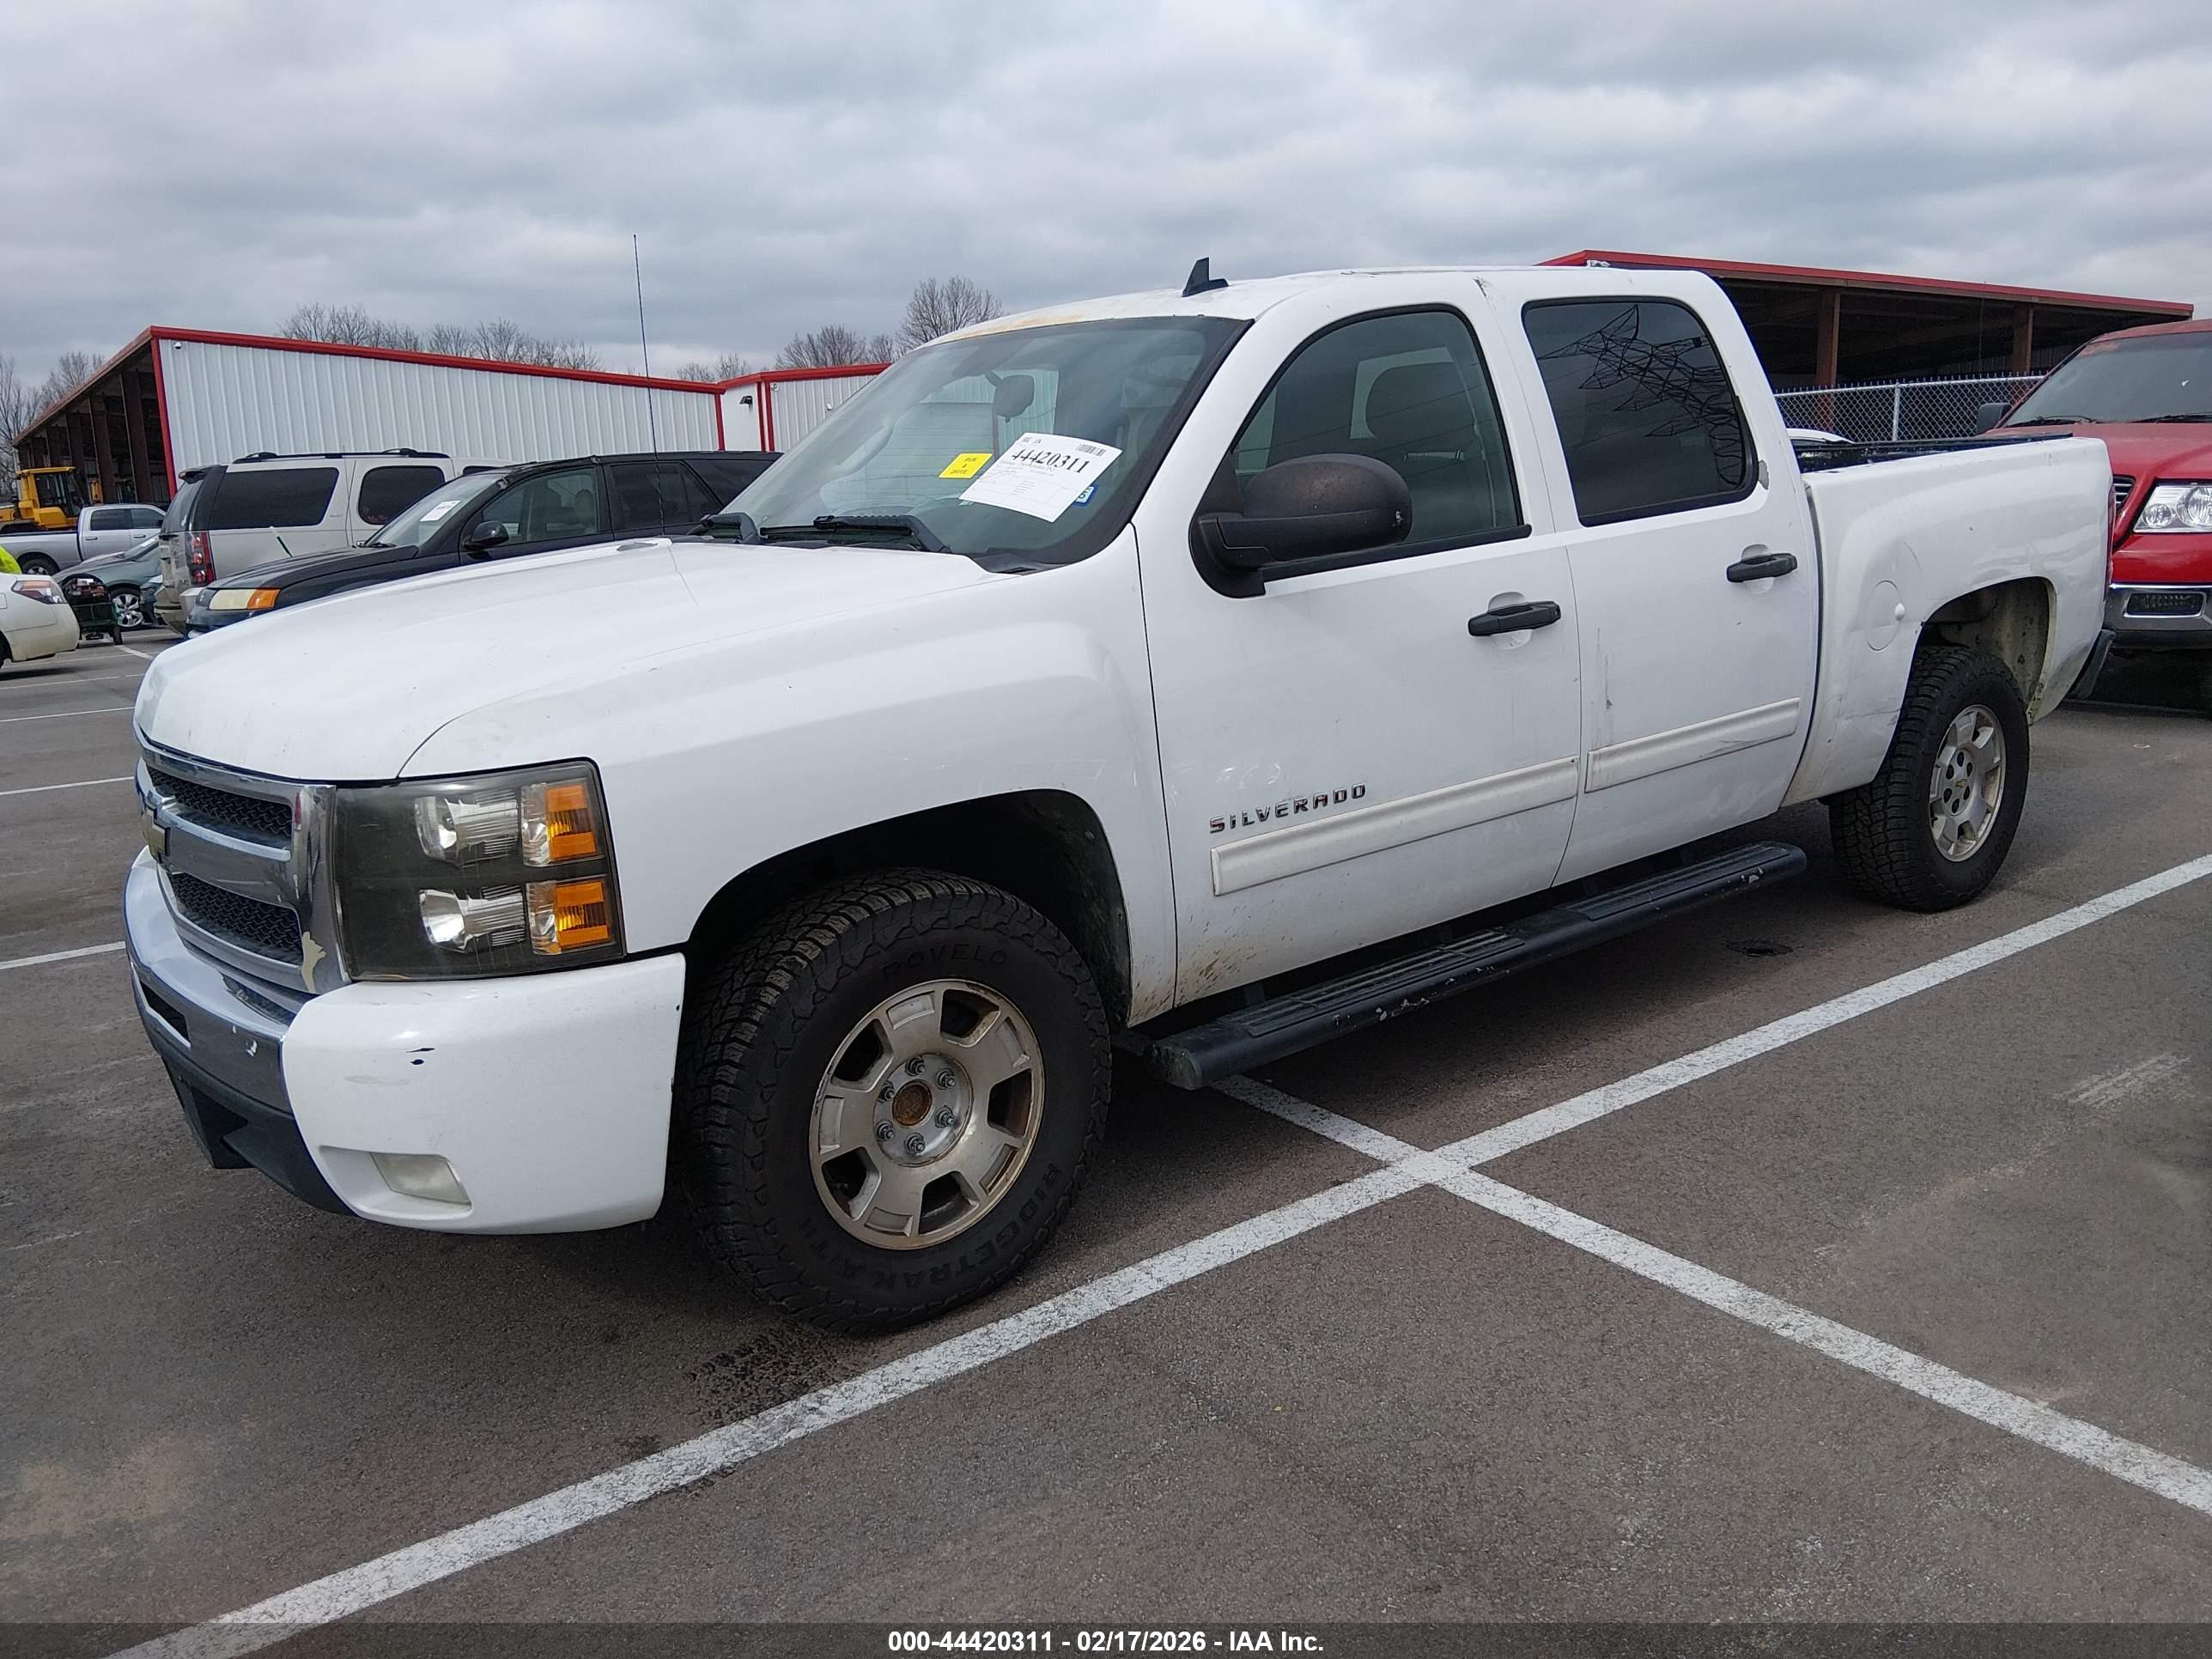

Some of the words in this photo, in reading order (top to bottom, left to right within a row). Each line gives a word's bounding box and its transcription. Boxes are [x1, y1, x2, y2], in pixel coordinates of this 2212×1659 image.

[1012, 449, 1091, 473] 44420311
[1209, 782, 1366, 834] SILVERADO
[880, 940, 1008, 981] ROVELO
